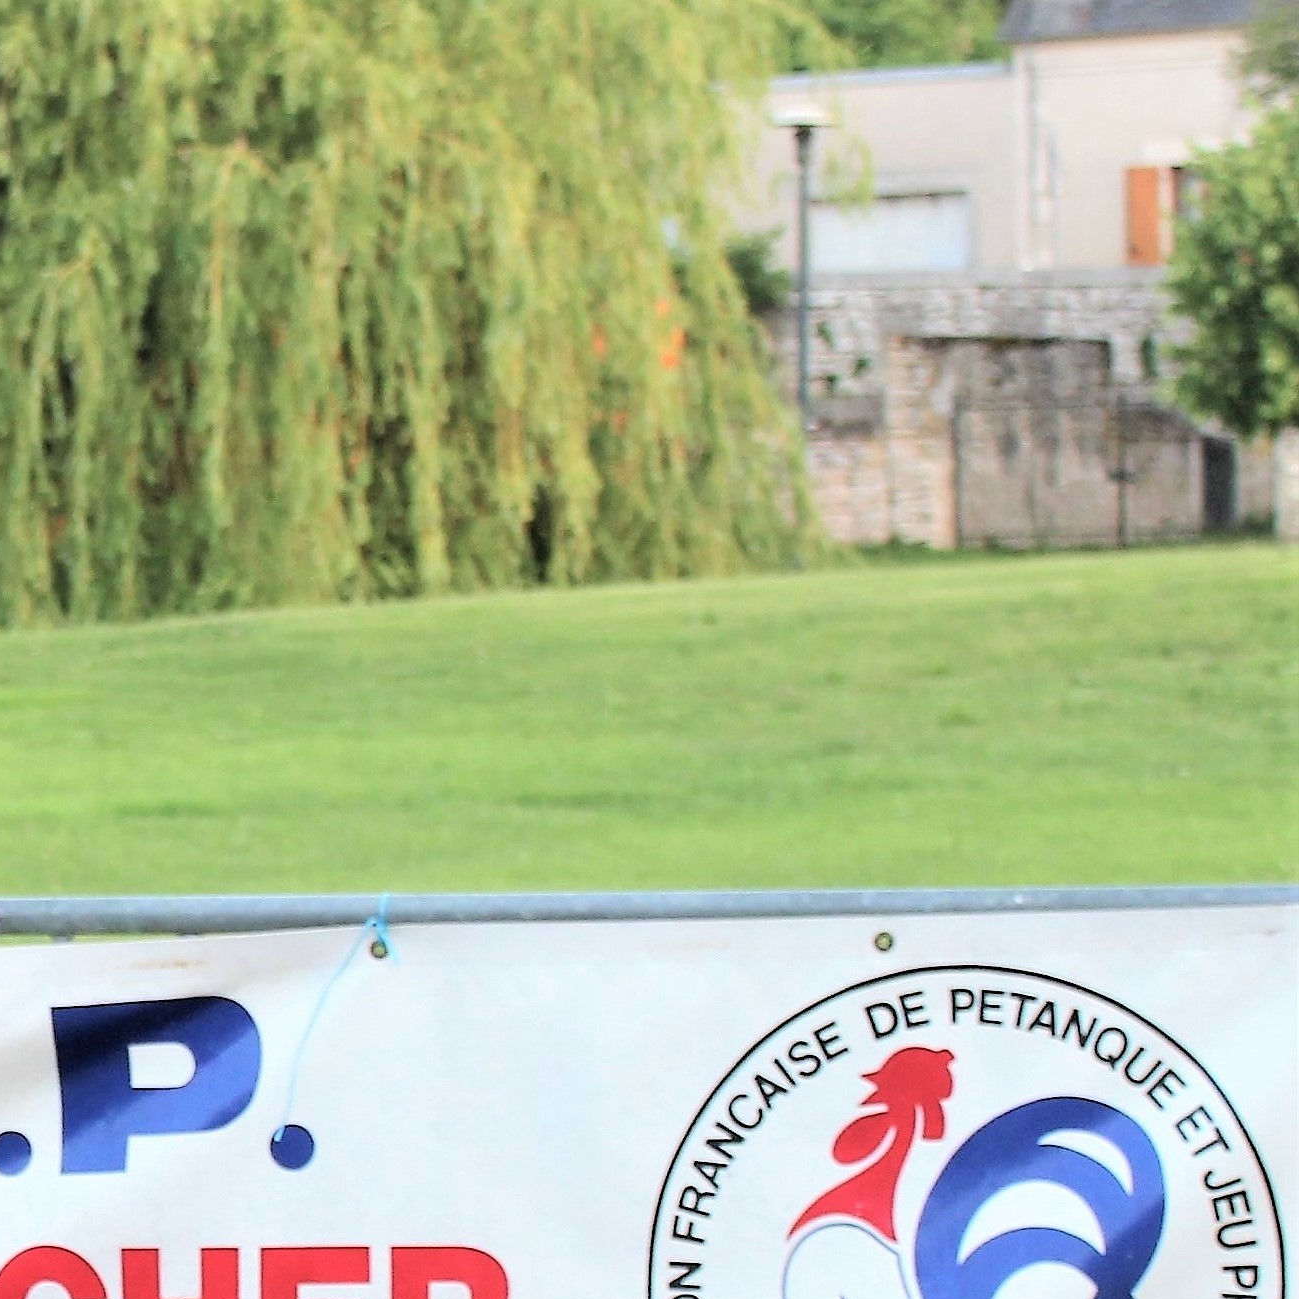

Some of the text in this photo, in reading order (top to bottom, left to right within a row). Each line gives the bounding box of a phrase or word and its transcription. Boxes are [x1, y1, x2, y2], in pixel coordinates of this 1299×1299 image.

[865, 991, 930, 1039] DE
[950, 988, 1188, 1109] PETANQUE
[671, 1021, 850, 1245] FRANCAISE
[1174, 1105, 1232, 1158] ET
[1202, 1167, 1257, 1254] JEU
